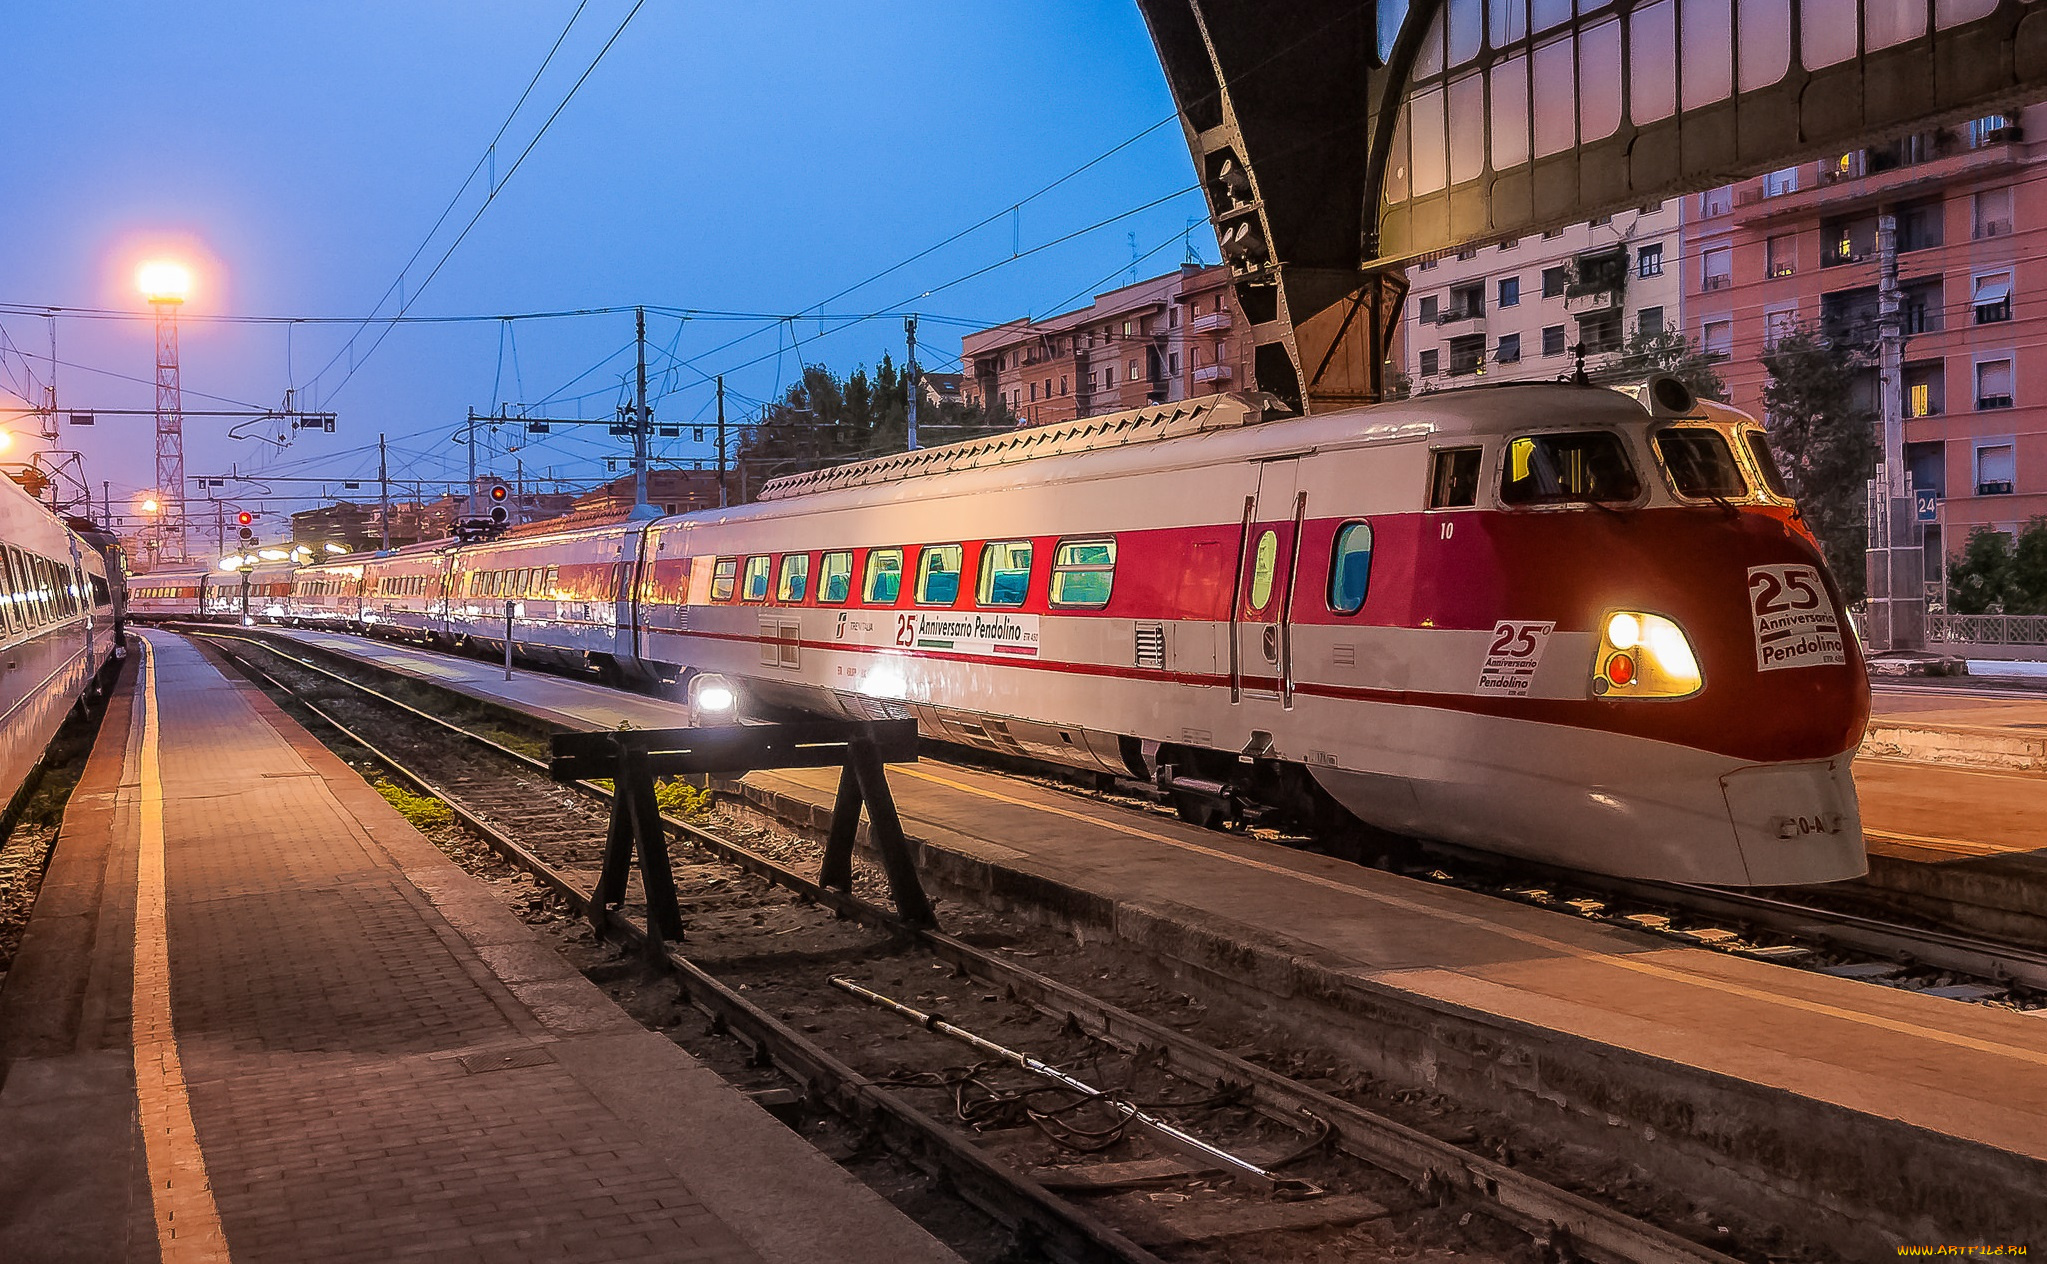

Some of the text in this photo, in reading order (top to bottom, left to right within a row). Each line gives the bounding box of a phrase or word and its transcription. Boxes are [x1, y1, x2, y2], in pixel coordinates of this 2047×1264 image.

[1918, 498, 1935, 513] 24
[1440, 522, 1454, 540] 10
[918, 613, 973, 638] Anniversario
[974, 615, 1022, 641] Pendolino
[1760, 612, 1836, 632] Anniversario
[1762, 635, 1842, 665] Pendolino
[1485, 657, 1537, 669] Anniversario
[1479, 675, 1528, 689] Pendolino
